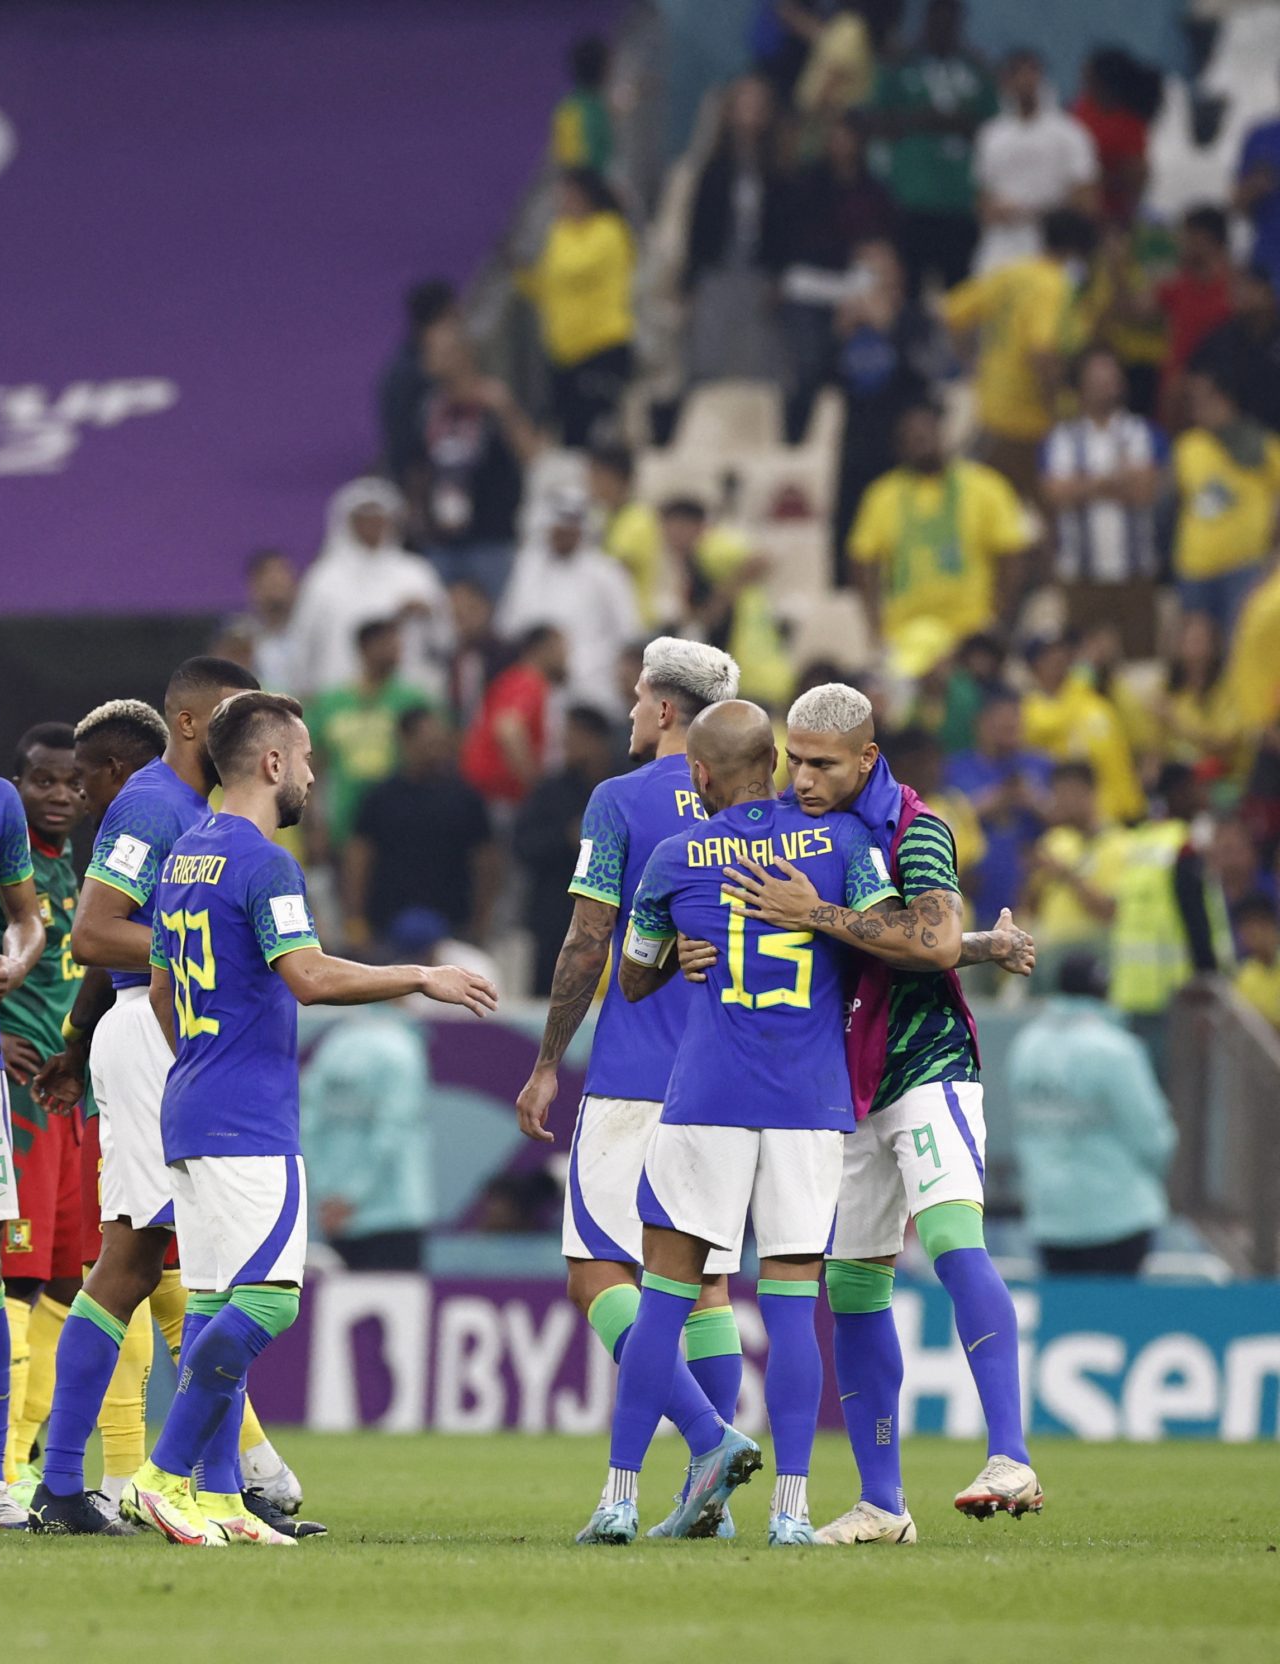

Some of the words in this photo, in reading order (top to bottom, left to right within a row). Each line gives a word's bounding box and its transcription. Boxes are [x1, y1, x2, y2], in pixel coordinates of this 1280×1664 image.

[675, 790, 709, 821] PE
[688, 837, 748, 867] DANI
[170, 855, 227, 885] RIBEIRO
[720, 888, 814, 1009] 13
[161, 908, 220, 1040] 22
[911, 1122, 941, 1168] 9
[876, 1414, 892, 1445] BRASIL
